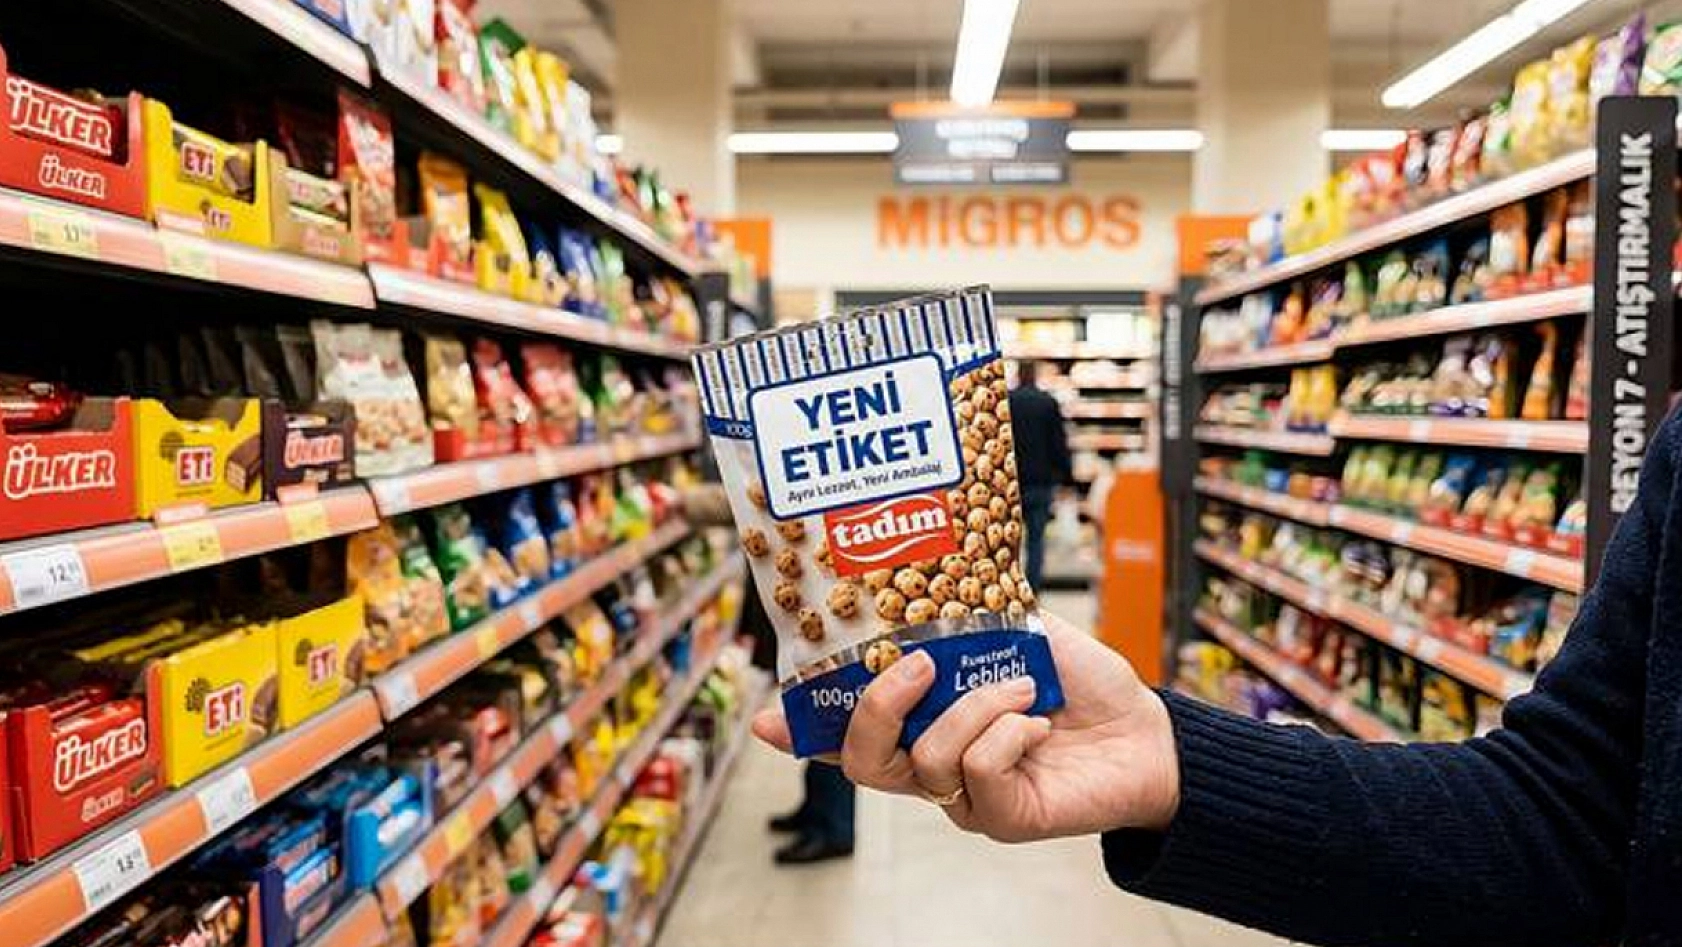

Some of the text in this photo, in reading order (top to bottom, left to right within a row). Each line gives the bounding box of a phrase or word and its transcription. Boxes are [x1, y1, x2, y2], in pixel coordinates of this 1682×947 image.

[6, 78, 112, 156] ÜLKER
[39, 154, 105, 200] ÜLKER
[1615, 133, 1656, 357] ATIŞTIRMALIK
[795, 370, 902, 431] YENİ
[1614, 378, 1647, 400] 7
[5, 443, 117, 498] ÜLKER
[781, 419, 932, 483] ETİKET
[862, 471, 889, 487] Yeni
[833, 506, 949, 549] tadım
[954, 655, 1026, 692] Leblebi
[54, 718, 147, 792] ÜLKER
